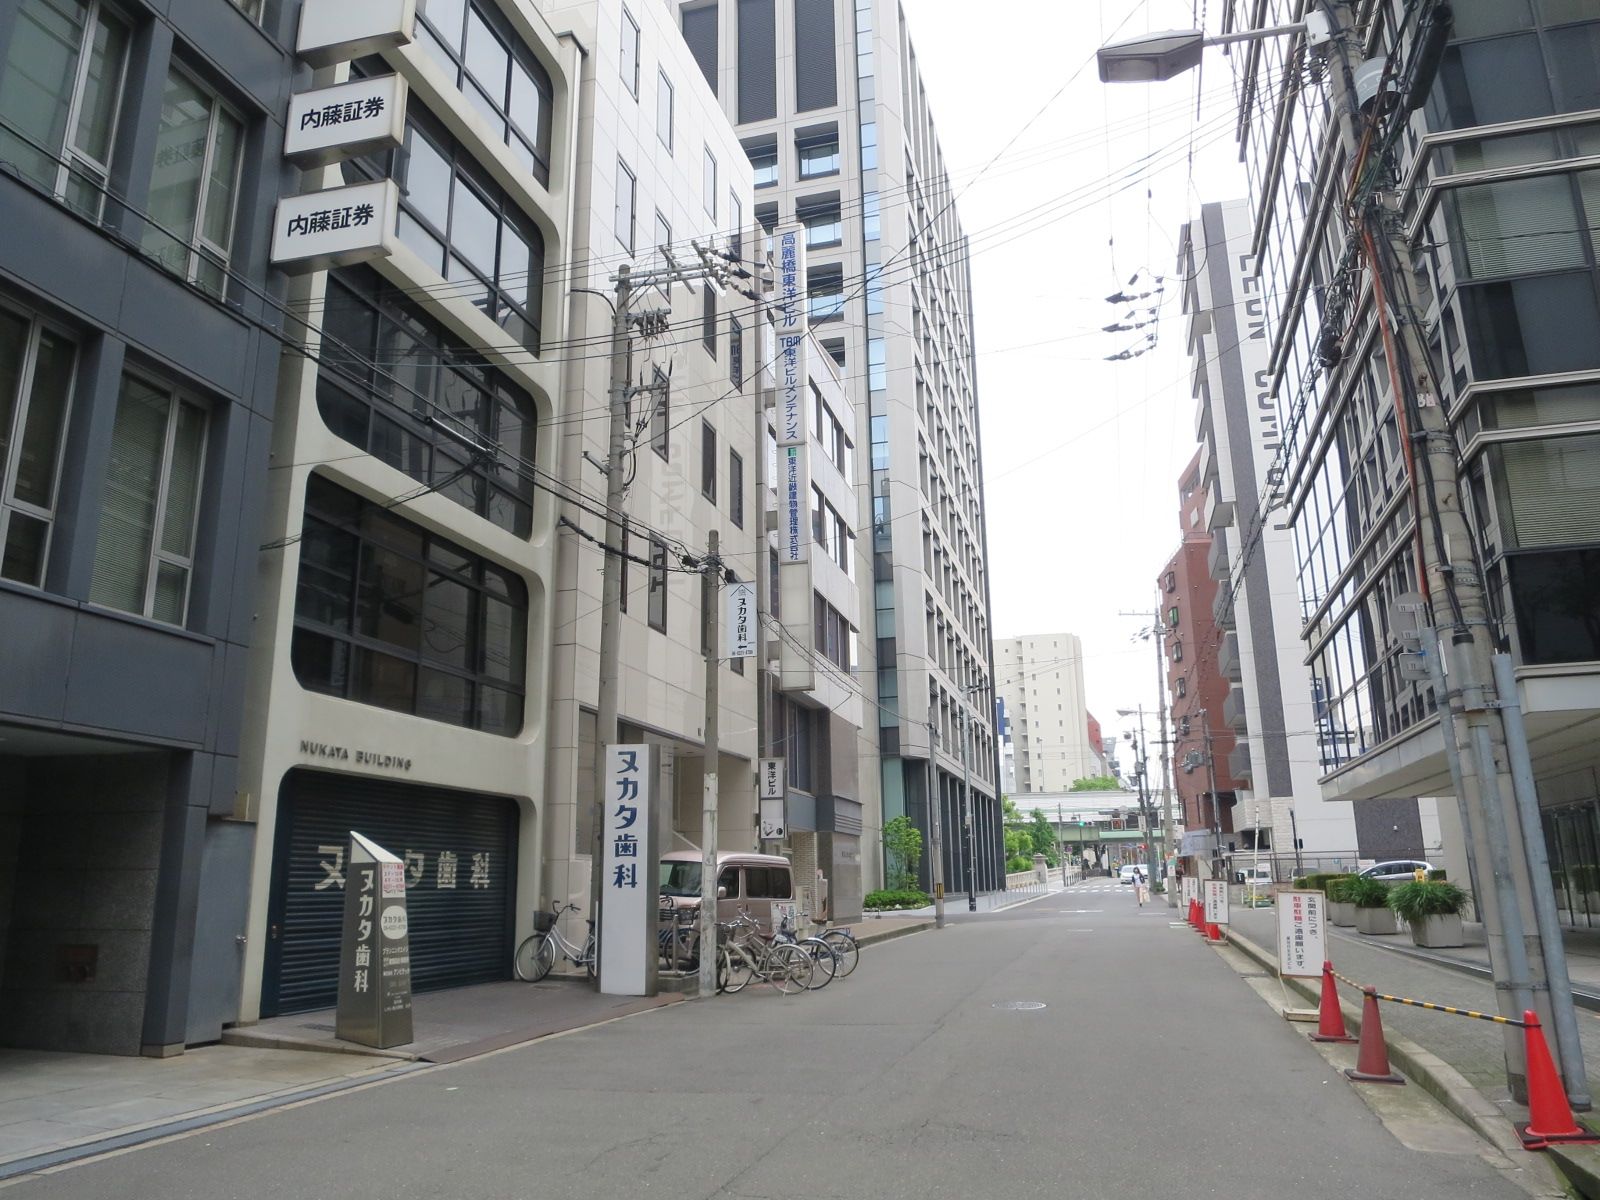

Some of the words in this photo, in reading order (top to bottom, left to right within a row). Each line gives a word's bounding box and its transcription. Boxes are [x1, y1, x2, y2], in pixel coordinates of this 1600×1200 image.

[300, 96, 385, 131] 内藤証券
[287, 203, 375, 237] 内藤証券
[781, 231, 797, 328] 高麗橋東洋ビル
[737, 597, 747, 642] ヌカタ歯科
[300, 740, 349, 761] NUKATA
[355, 750, 412, 771] BUILDING
[767, 762, 777, 796] 東洋ビル
[613, 750, 639, 889] ヌカタ歯科
[314, 845, 491, 891] ヌタ歯科
[353, 869, 375, 993] ヌカタ歯科
